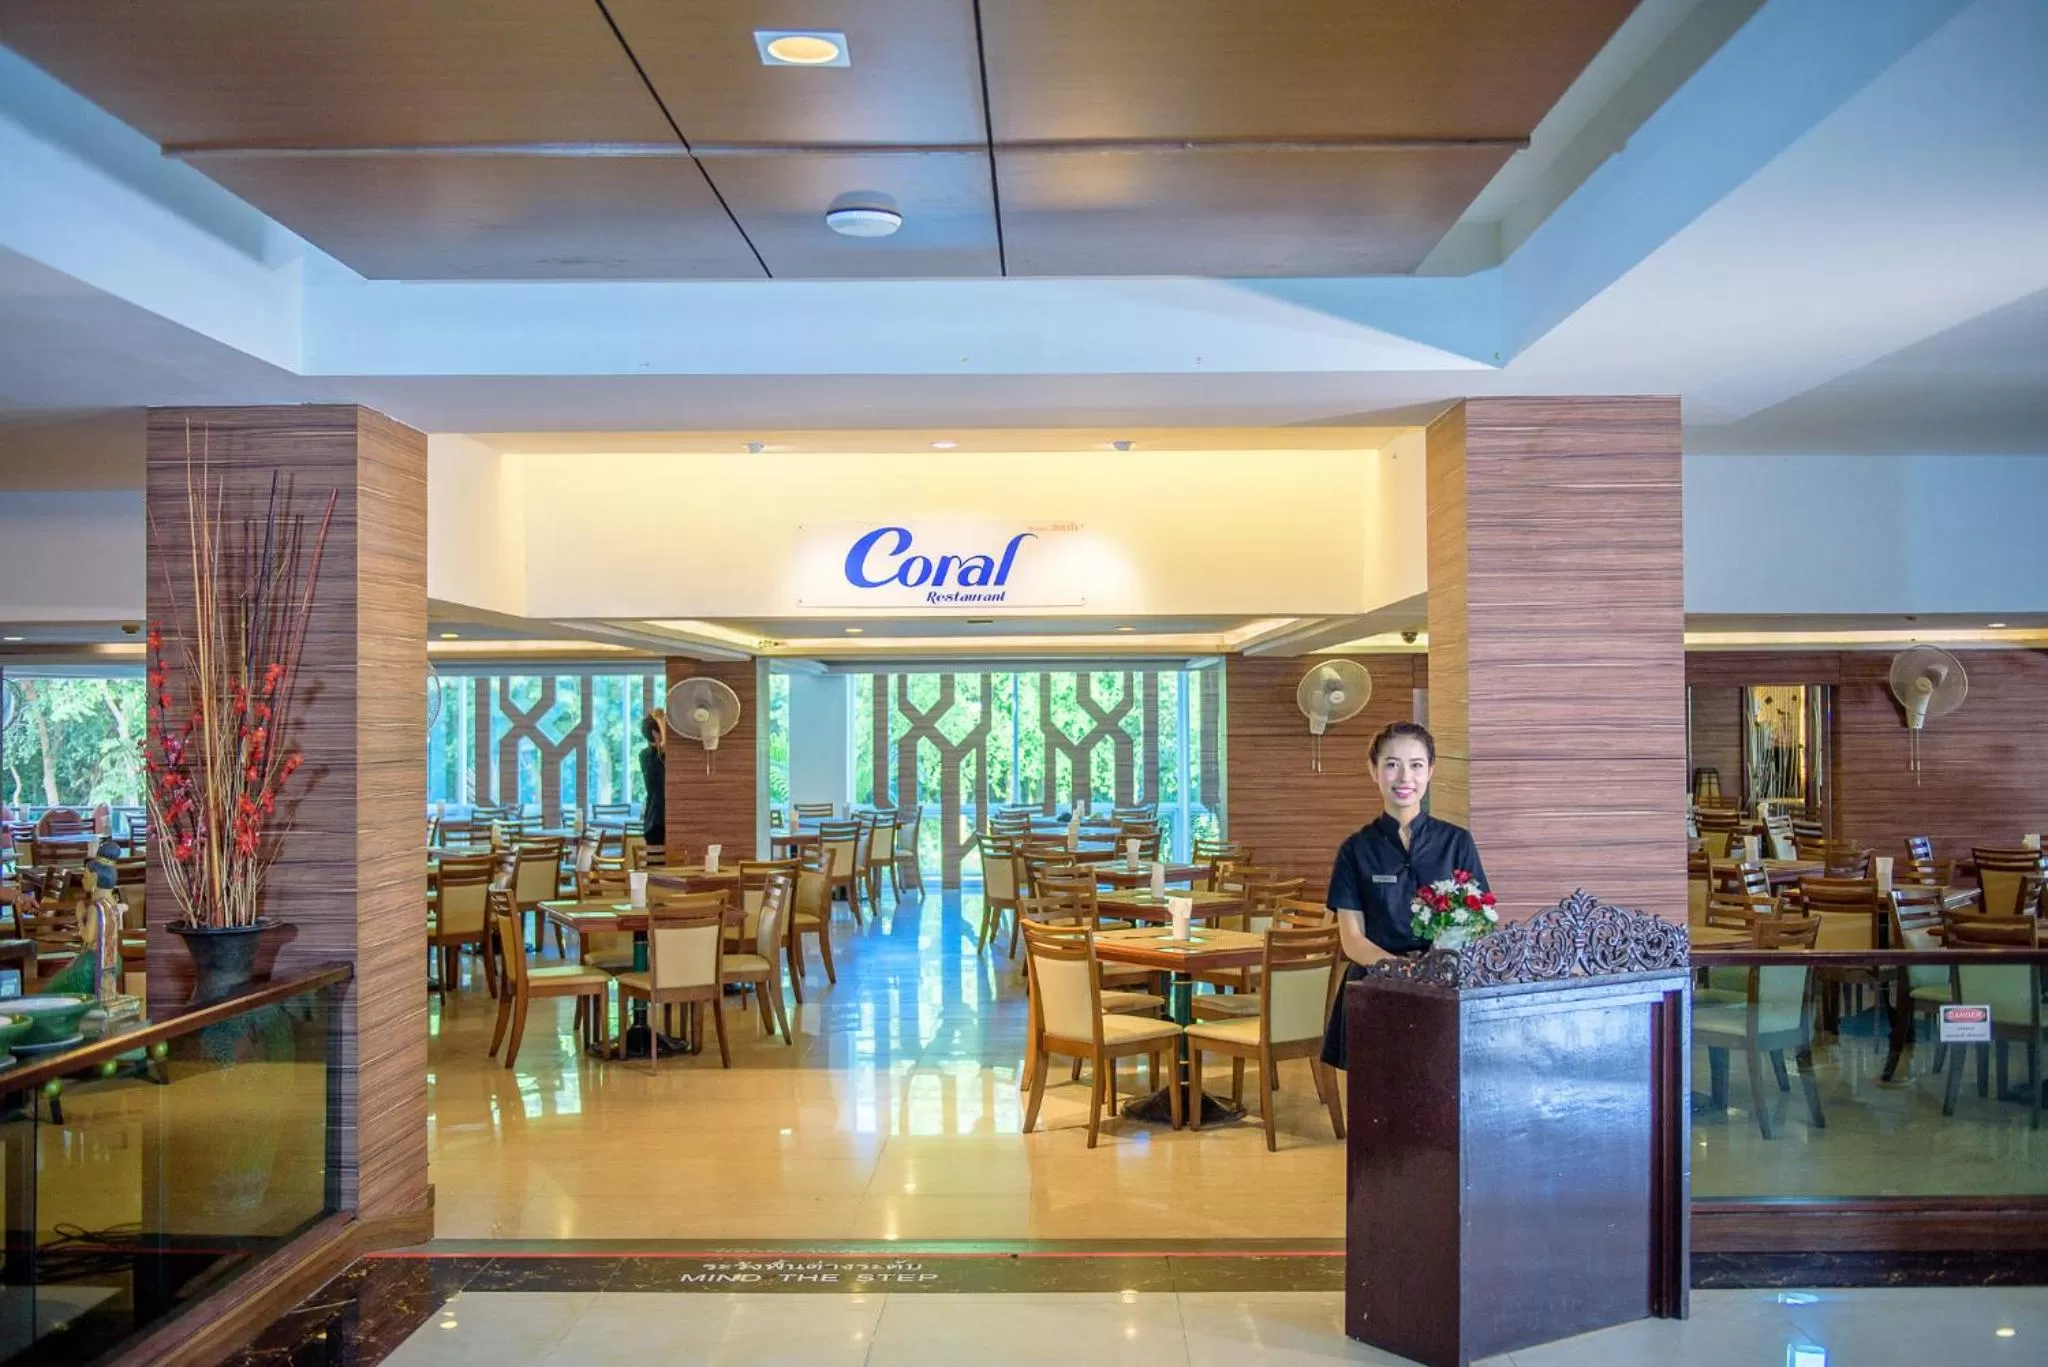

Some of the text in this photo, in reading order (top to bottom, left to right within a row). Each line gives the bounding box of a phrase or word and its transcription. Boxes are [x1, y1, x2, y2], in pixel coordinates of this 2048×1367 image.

[845, 526, 1038, 588] Coral
[926, 590, 1006, 604] Restaurant
[679, 1273, 939, 1282] MIND THE STEP
